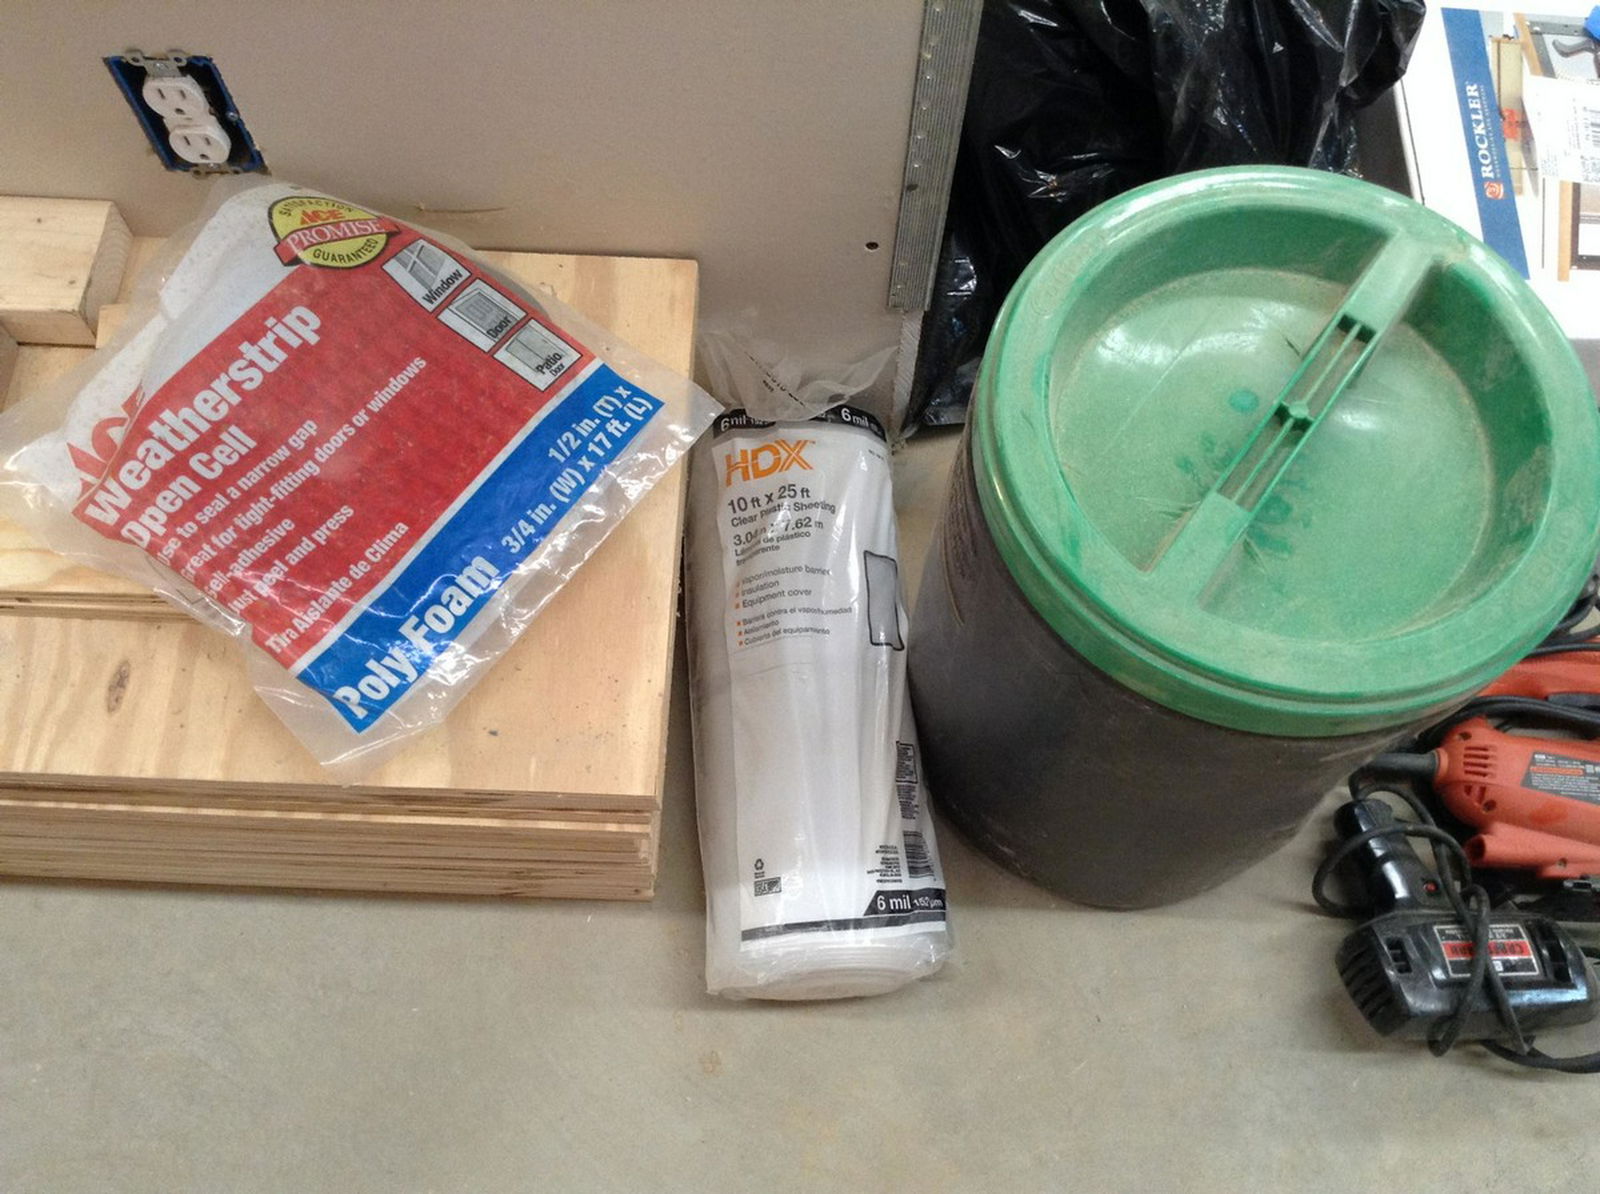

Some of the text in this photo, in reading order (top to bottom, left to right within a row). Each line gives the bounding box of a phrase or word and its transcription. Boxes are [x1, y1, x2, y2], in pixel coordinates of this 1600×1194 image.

[1465, 83, 1494, 179] ROCKLER
[287, 219, 385, 256] PROMISE
[313, 238, 378, 263] GUARANTEED
[421, 269, 463, 305] Window
[487, 315, 514, 339] Door
[535, 352, 563, 375] Patio
[550, 363, 565, 377] Door
[549, 386, 632, 463] 1/2 in. (T) x
[841, 407, 852, 422] 6
[852, 414, 869, 427] mil
[211, 525, 237, 549] for
[314, 423, 356, 463] doors
[352, 409, 370, 428] or
[366, 356, 427, 413] windows
[724, 439, 814, 487] HDX
[121, 425, 257, 548] Open Cell
[176, 521, 198, 538] to
[195, 494, 230, 525] seal
[227, 486, 241, 500] a
[237, 444, 291, 491] narrow
[288, 420, 318, 450] gap
[502, 397, 653, 554] 3/4 in. (W) x 17 ft. (L)
[728, 484, 811, 514] 10 ft x 25 ft
[284, 537, 316, 566] and
[311, 504, 355, 546] press
[731, 511, 757, 527] Clear
[348, 560, 371, 581] de
[364, 521, 409, 564] Clima
[742, 588, 812, 608] Equipment cover
[877, 895, 886, 911] 6
[889, 894, 912, 910] mil
